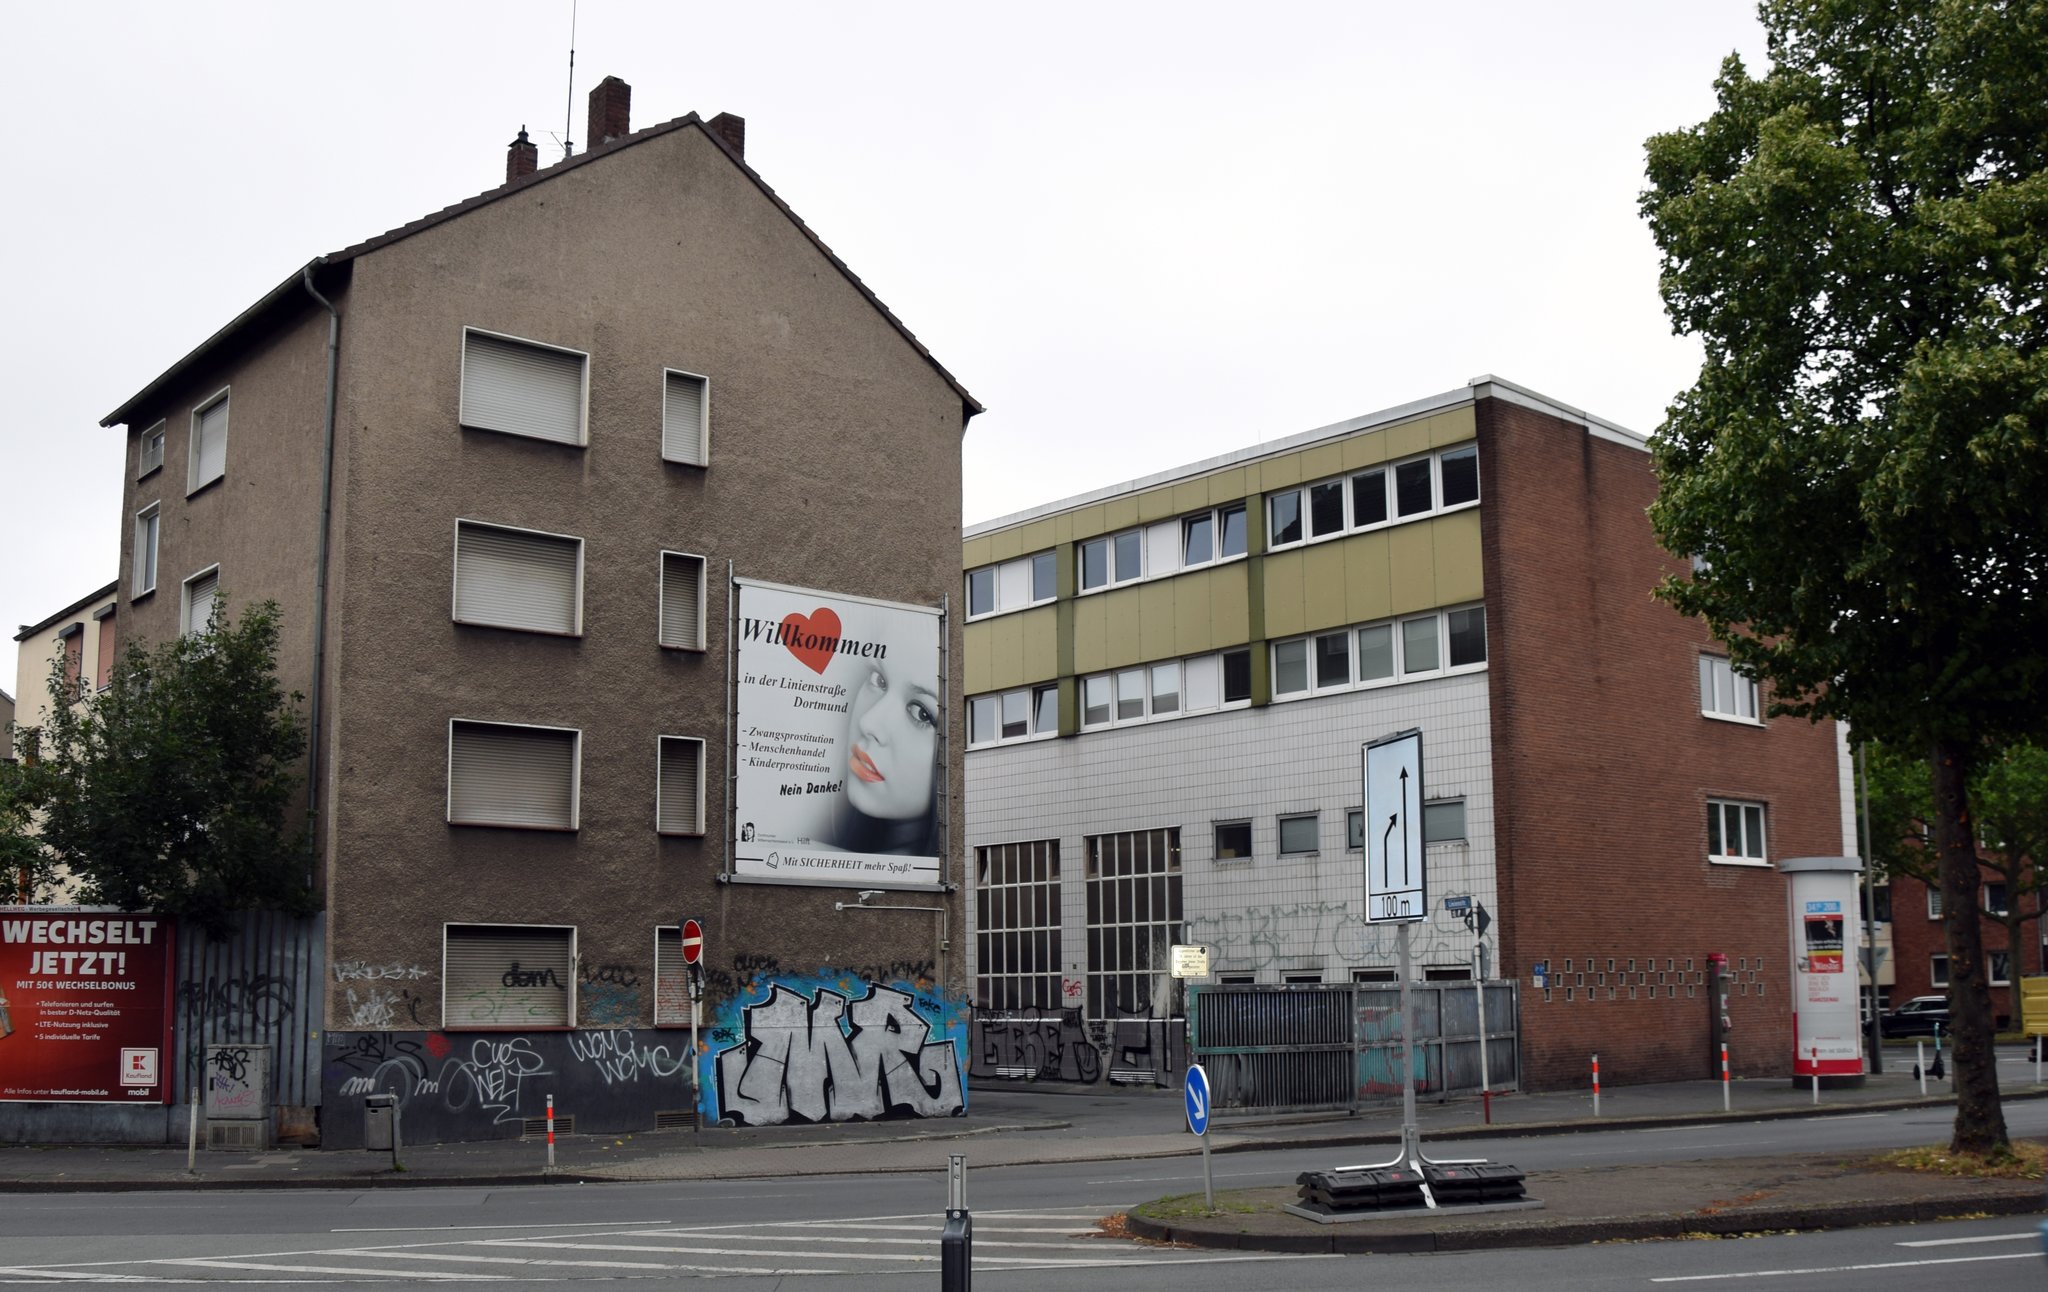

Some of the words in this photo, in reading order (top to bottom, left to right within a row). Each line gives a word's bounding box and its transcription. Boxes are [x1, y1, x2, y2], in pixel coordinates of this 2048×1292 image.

[744, 617, 888, 659] Willkommen
[744, 672, 756, 684] in
[759, 674, 778, 687] der
[780, 677, 847, 698] Linienstraße
[793, 696, 849, 713] Dortmund
[749, 726, 834, 745] Zwangsprostitution
[749, 741, 826, 758] Menschenhandel
[748, 756, 831, 773] Kinderprostitution
[779, 783, 802, 796] Nein
[806, 780, 843, 794] Danke!
[782, 856, 798, 867] Mit
[799, 857, 863, 870] SICHERHEIT
[864, 862, 887, 871] mehr
[887, 862, 912, 874] Spaß!
[1382, 895, 1398, 918] 100
[1401, 899, 1411, 916] m
[2, 920, 158, 944] WECHSELT
[29, 951, 126, 975] JETZT!
[16, 980, 35, 989] MIT
[36, 981, 53, 989] 50€
[56, 981, 136, 990] WECHSELBONUS
[41, 1000, 80, 1008] Telefonieren
[39, 1021, 81, 1029] LTE-Nutzung
[81, 1021, 109, 1029] inklusive
[50, 1087, 109, 1096] kaufland-mobil.de
[128, 1088, 150, 1096] mobil
